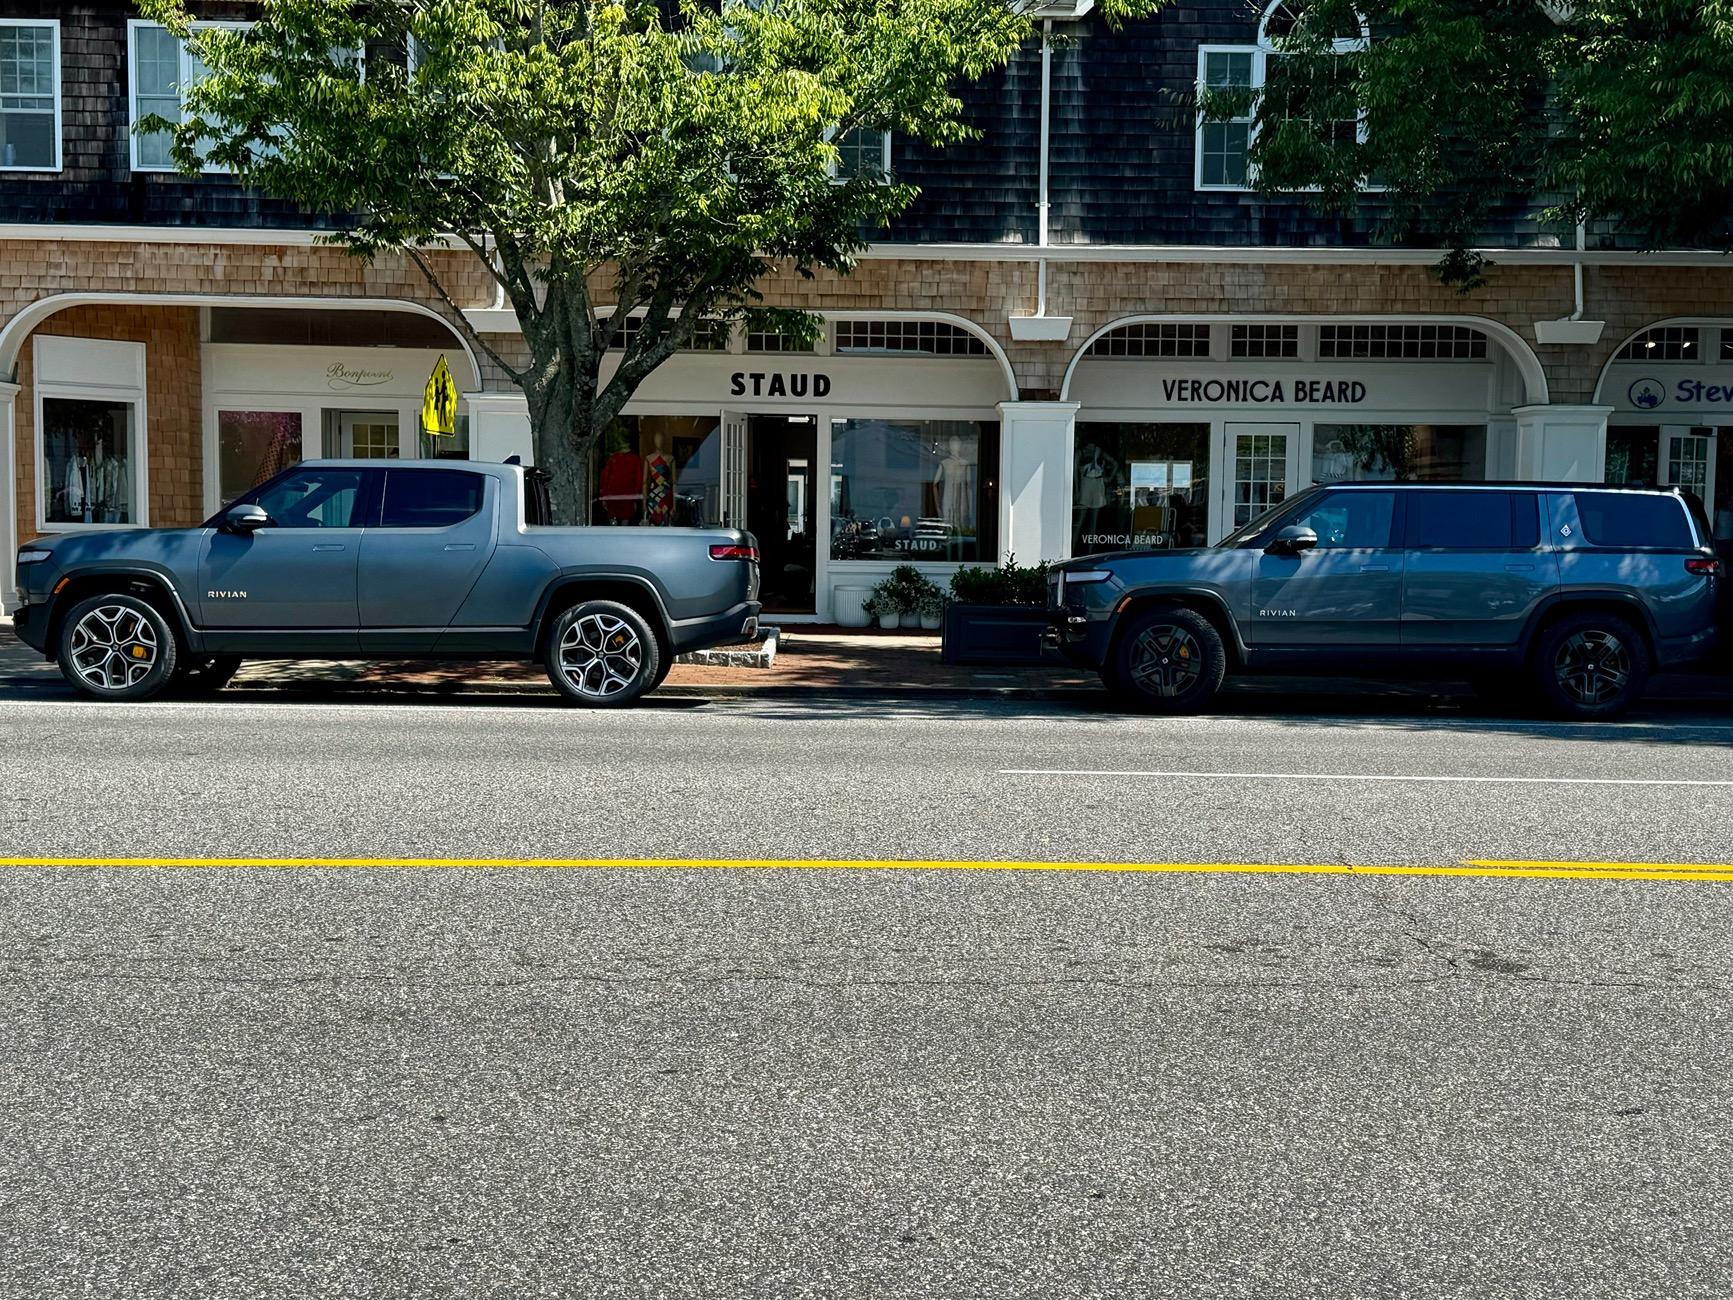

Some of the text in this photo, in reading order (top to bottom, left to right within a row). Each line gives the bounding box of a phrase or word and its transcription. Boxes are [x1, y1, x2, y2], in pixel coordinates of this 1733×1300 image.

[730, 372, 831, 397] STAUD
[1162, 379, 1366, 403] VERONICA BEARD
[895, 540, 937, 550] STAUD
[1082, 534, 1163, 545] VERONICA BEARD
[1259, 609, 1296, 617] RIVIAN
